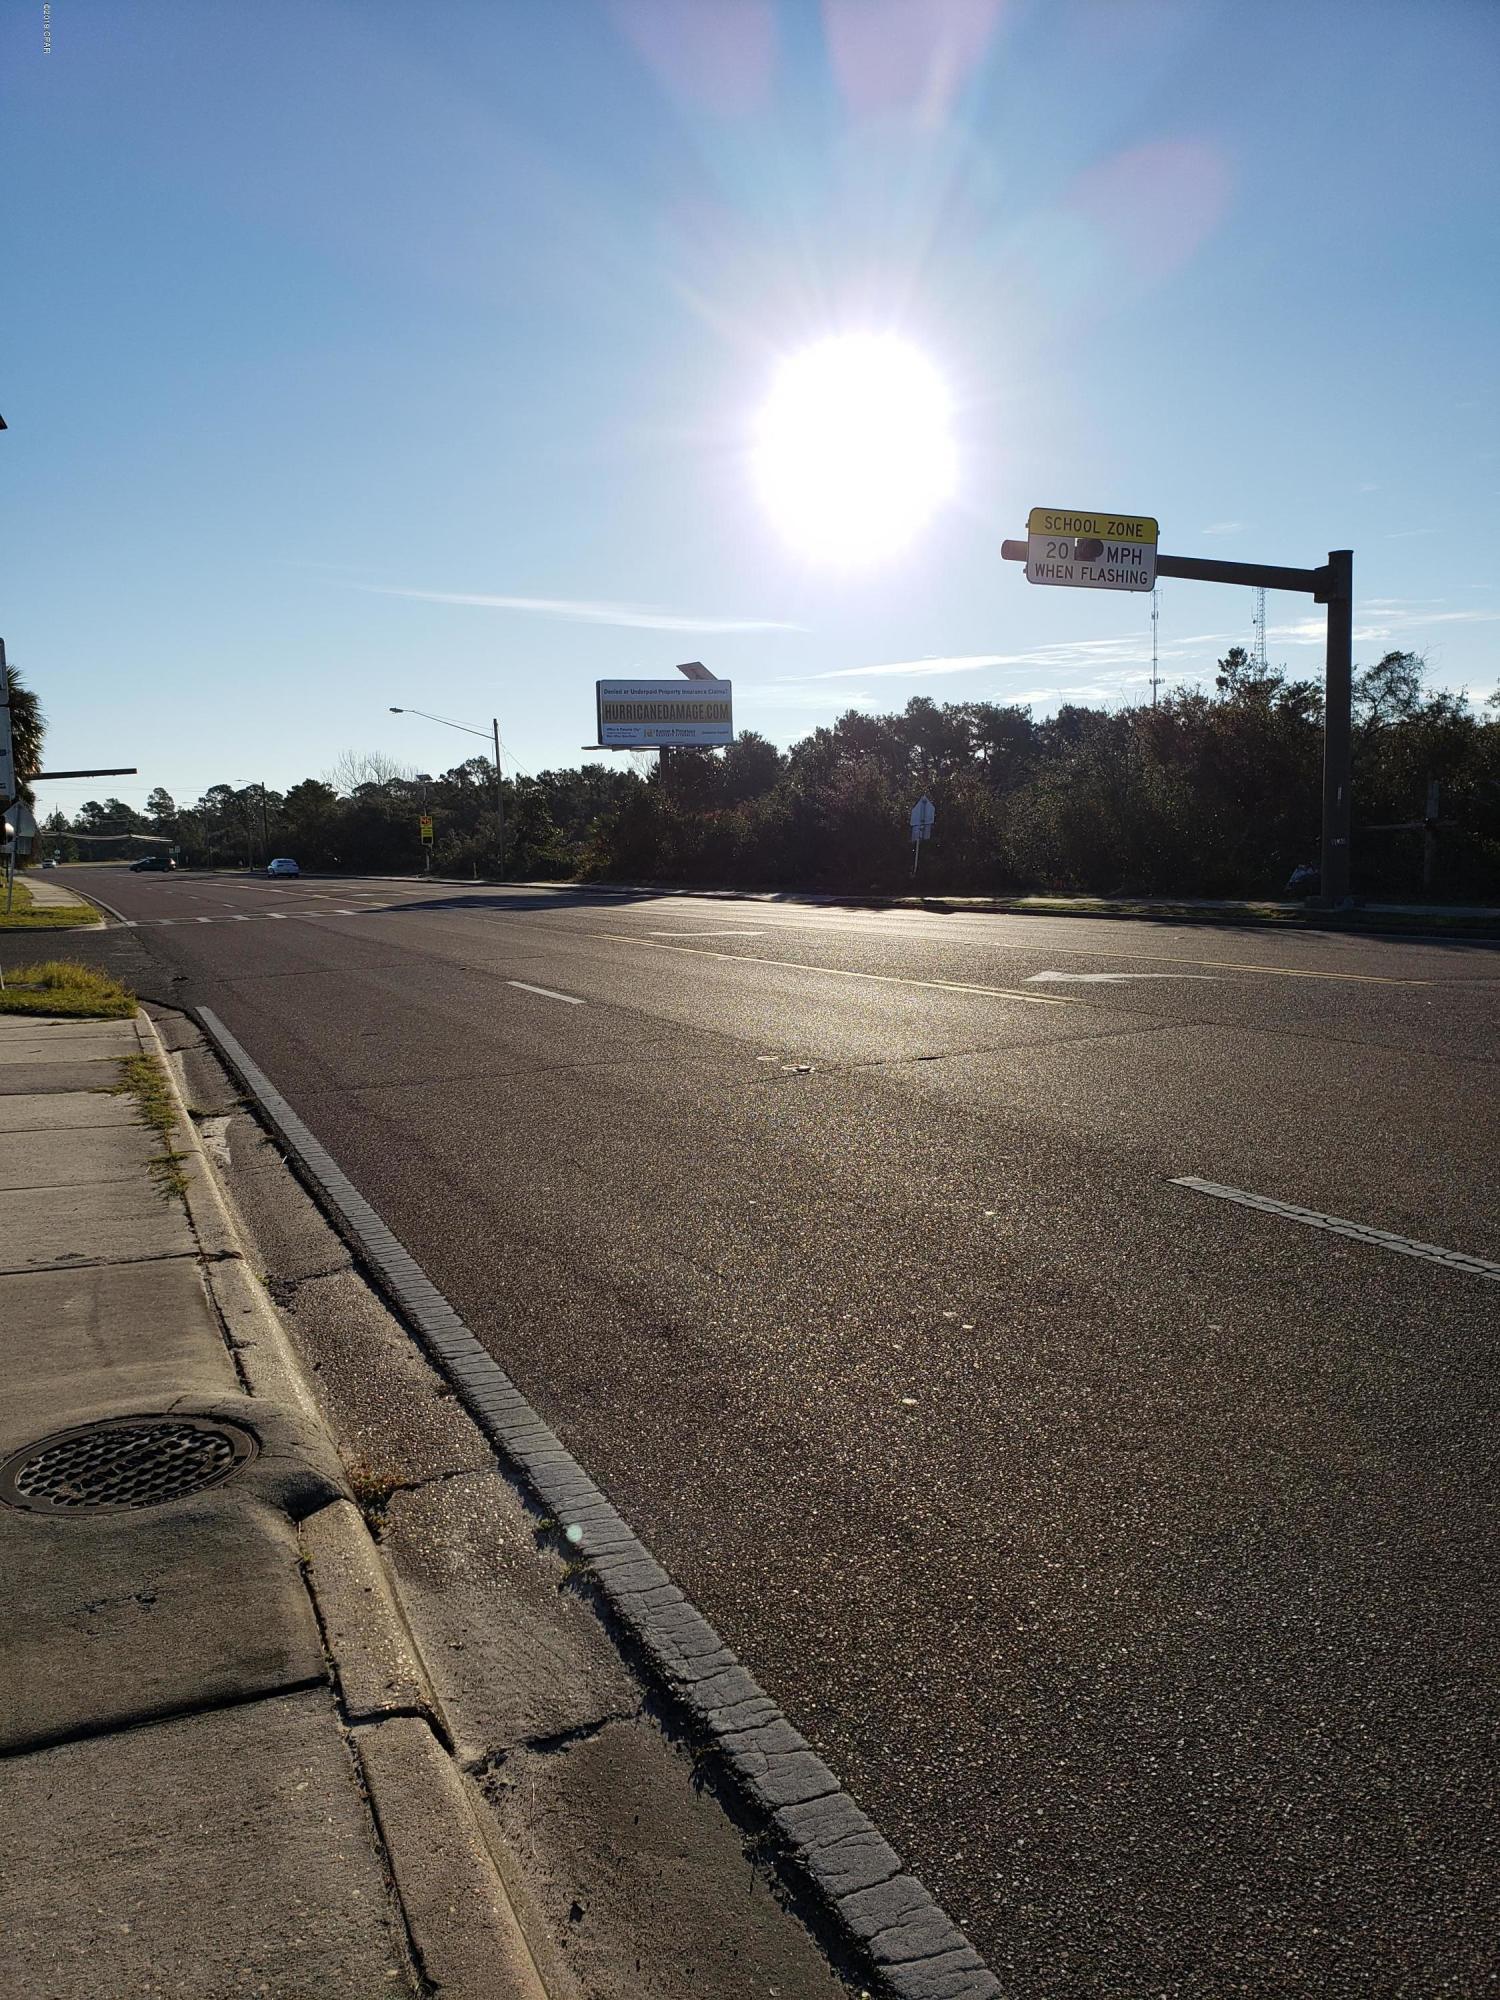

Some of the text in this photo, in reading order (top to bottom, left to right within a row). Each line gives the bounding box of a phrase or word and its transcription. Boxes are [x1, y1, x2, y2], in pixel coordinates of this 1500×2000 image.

[1044, 516, 1144, 537] SCHOOL ZONE
[1046, 542, 1142, 565] 20 MPH
[1035, 563, 1148, 585] WHEN FLASHING
[630, 688, 657, 696] Underpaid
[604, 703, 729, 721] HURRICANEDAMAGE.COM
